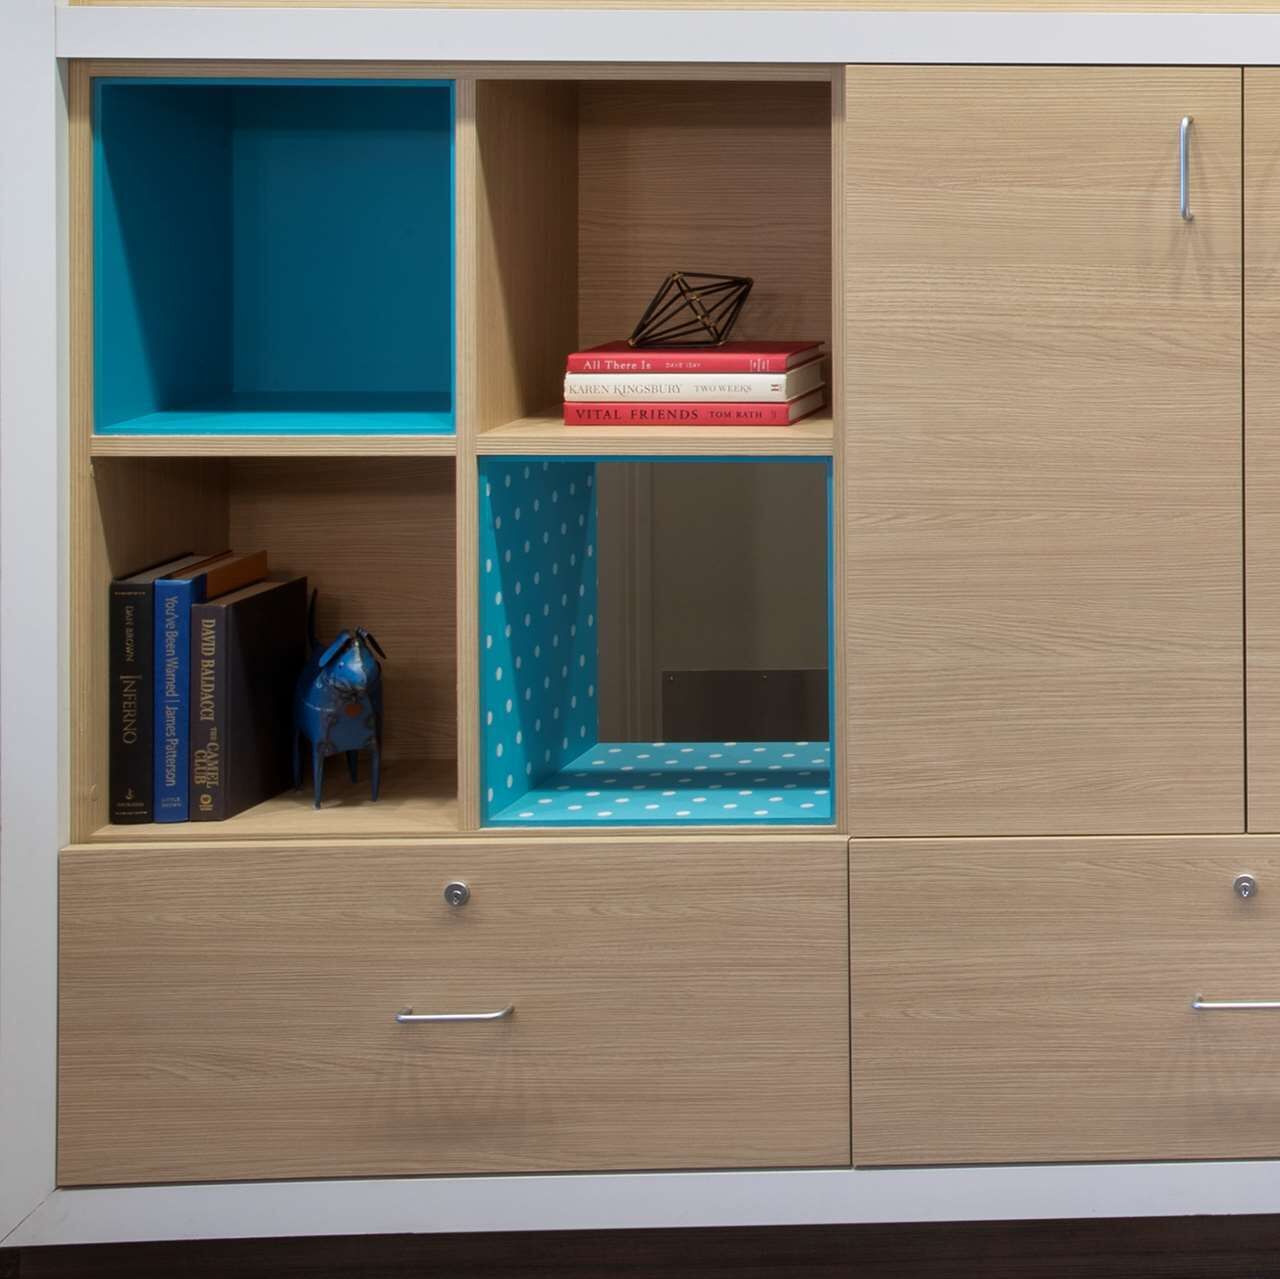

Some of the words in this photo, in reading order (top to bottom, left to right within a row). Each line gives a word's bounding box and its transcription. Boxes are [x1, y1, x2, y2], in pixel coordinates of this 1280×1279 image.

[583, 360, 600, 370] All
[604, 360, 637, 370] There
[641, 360, 652, 370] Is
[569, 384, 609, 394] KAREN
[613, 383, 683, 398] KINGSBURY
[694, 384, 717, 393] TWO
[719, 384, 753, 393] WEEKS
[576, 409, 621, 420] VITAL
[630, 409, 699, 420] FRIENDS
[709, 410, 732, 419] TOM
[736, 410, 762, 419] RATH
[125, 605, 135, 625] DAN
[125, 627, 135, 662] BROWN
[165, 631, 179, 656] Been
[201, 619, 216, 656] DAVID
[165, 657, 180, 697] Warned
[199, 660, 216, 721] BALDACCI
[120, 674, 142, 744] INFERNO
[165, 705, 179, 737] James
[165, 738, 180, 786] Patterson
[194, 749, 207, 785] CLUB
[206, 742, 220, 789] CAMEL
